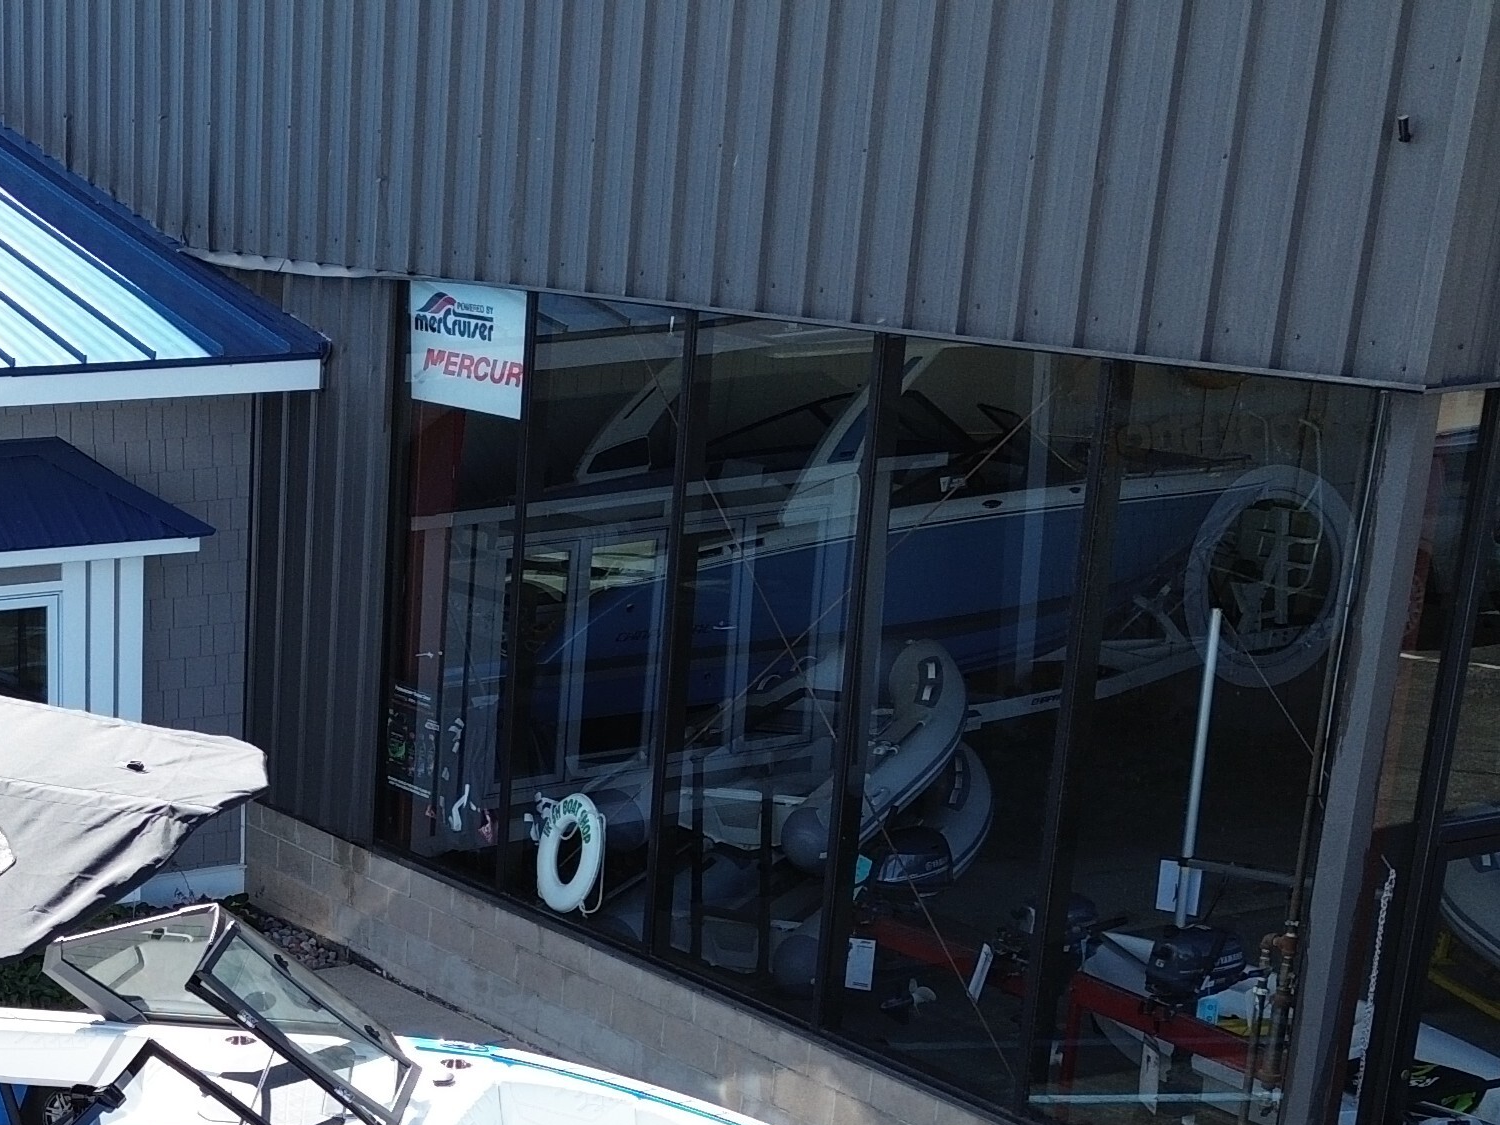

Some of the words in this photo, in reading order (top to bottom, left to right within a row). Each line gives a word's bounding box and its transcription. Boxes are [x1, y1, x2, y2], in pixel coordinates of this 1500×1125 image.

[457, 301, 484, 313] POWERED
[485, 305, 494, 315] BY
[423, 348, 524, 388] MERCUR
[563, 799, 582, 817] BOAT
